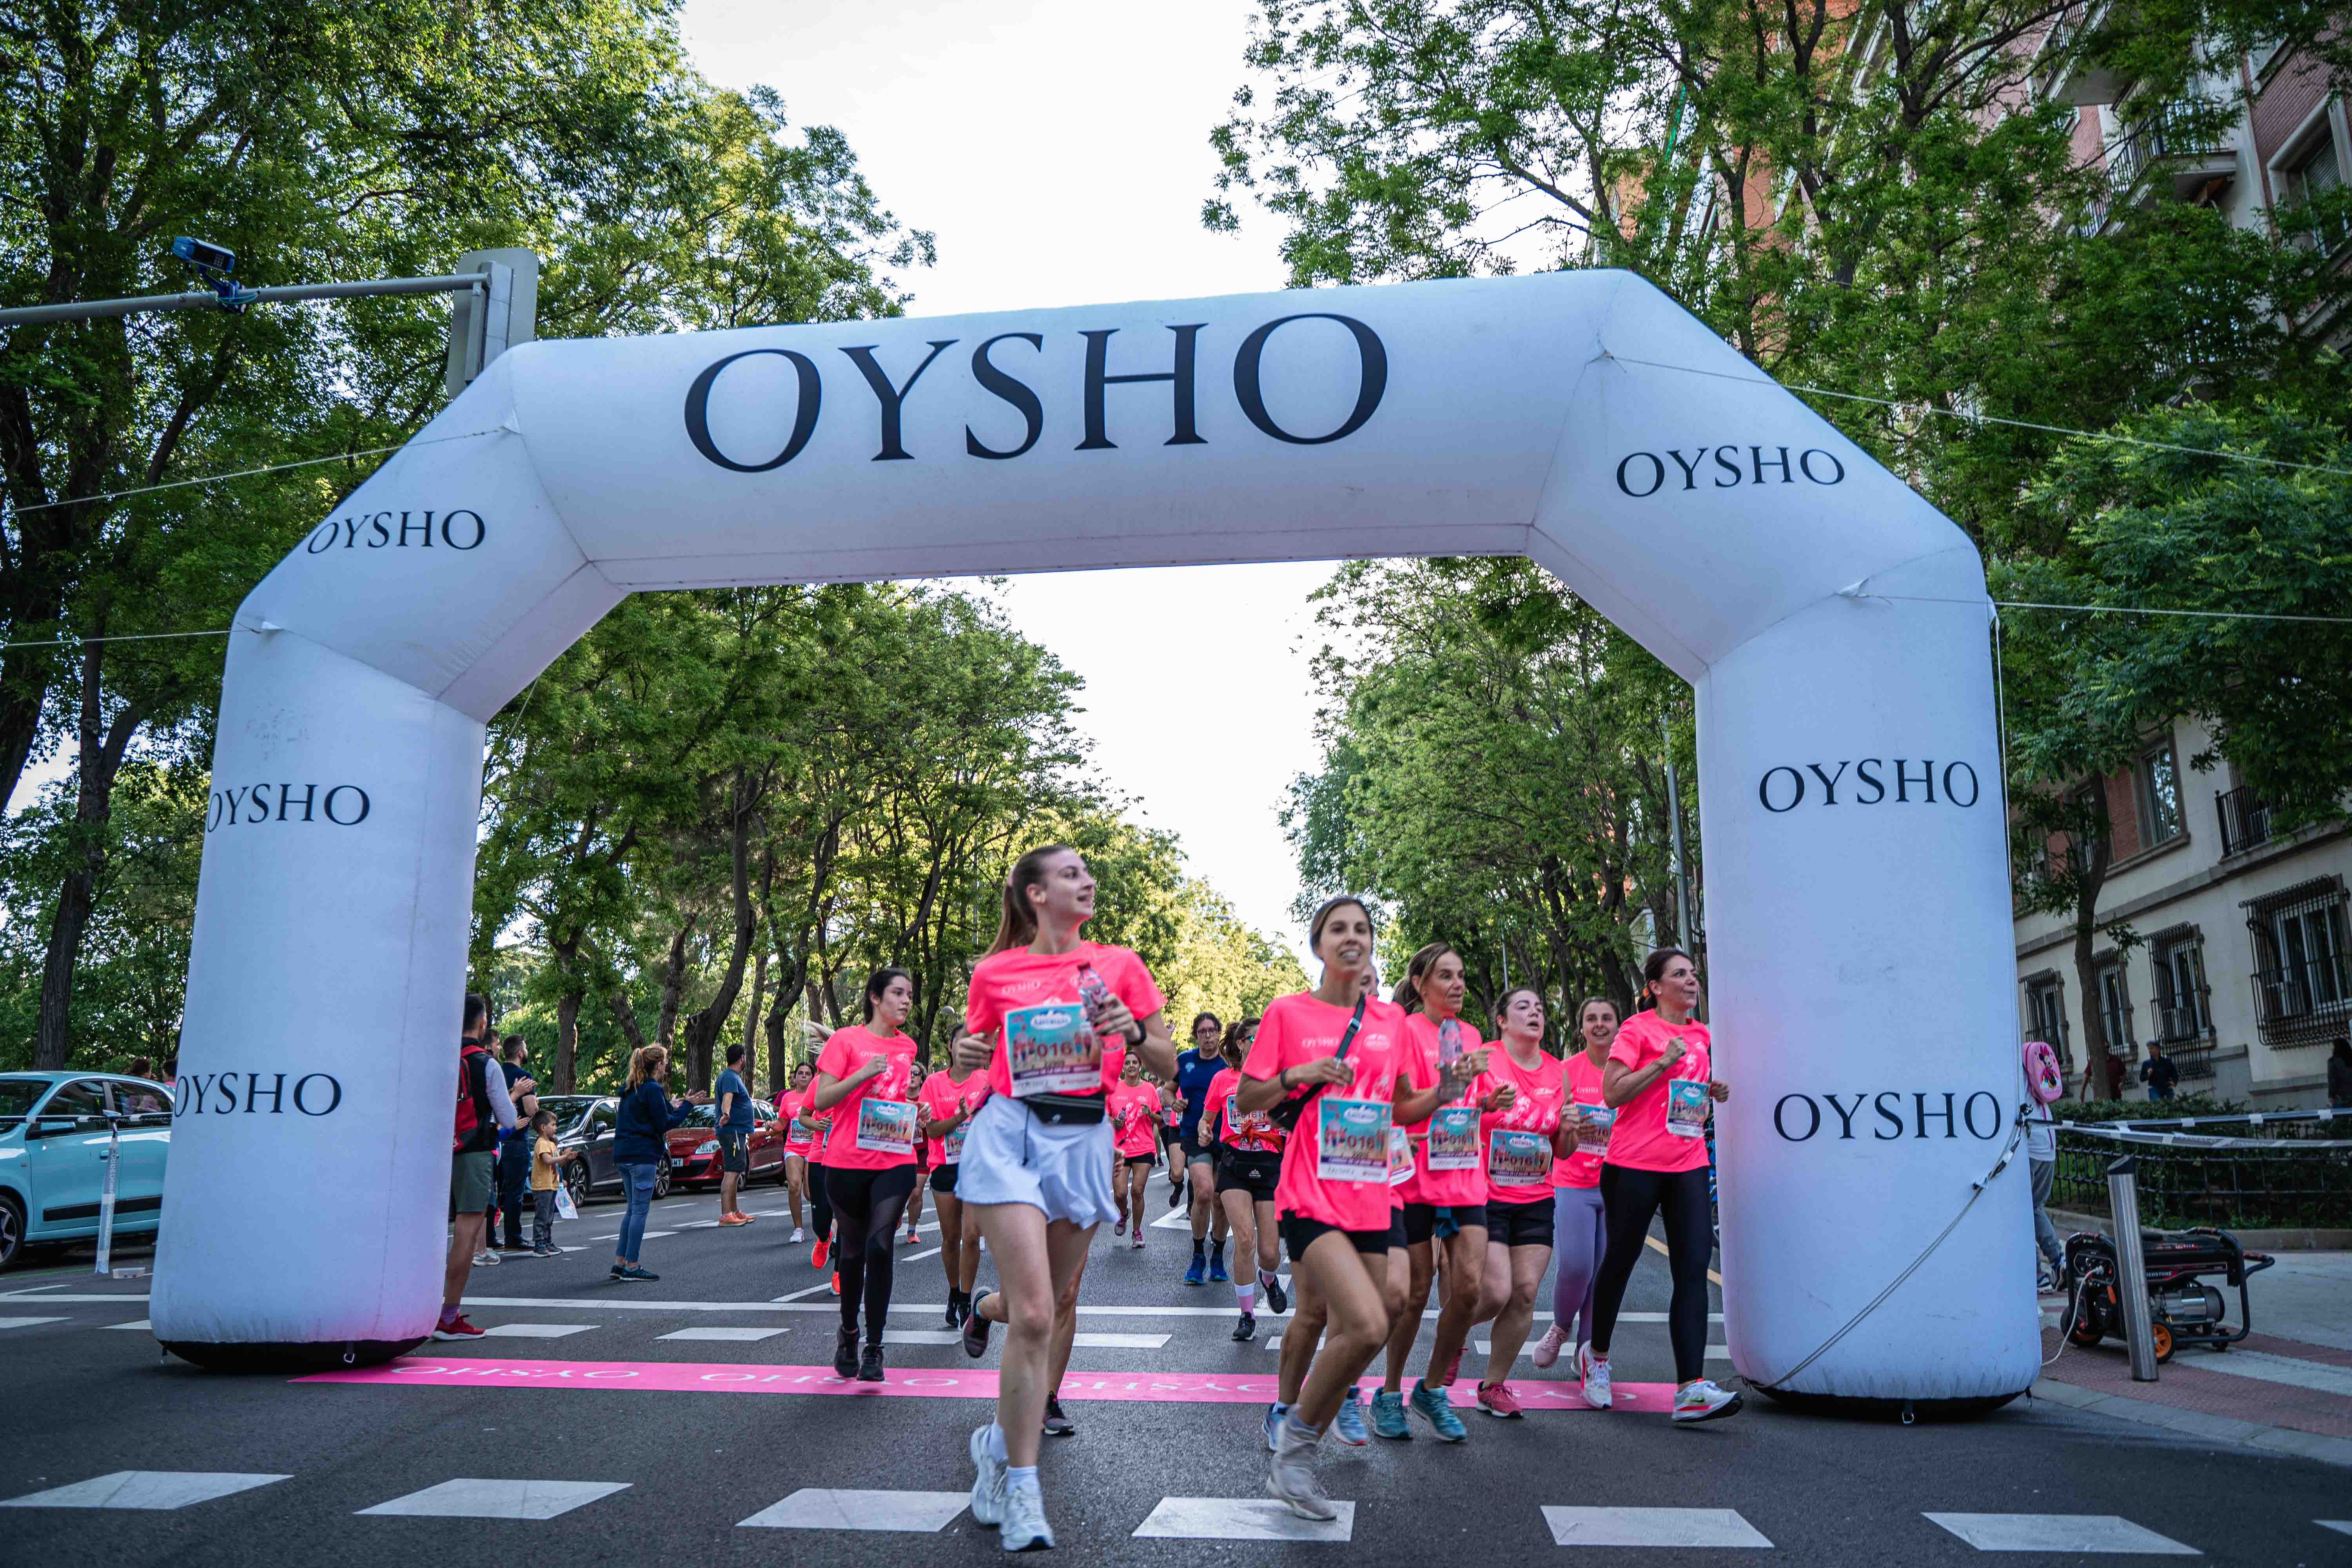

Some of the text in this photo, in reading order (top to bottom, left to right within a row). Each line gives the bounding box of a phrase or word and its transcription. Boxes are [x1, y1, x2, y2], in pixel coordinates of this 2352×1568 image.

[684, 313, 1388, 473] OYSHO
[1616, 445, 1845, 497] OYSHO
[307, 509, 486, 554] OYSHO
[207, 783, 371, 833] OYSHO
[1759, 759, 1979, 813] OYSHO
[1037, 1042, 1073, 1058] 016
[174, 1072, 342, 1118] OYSHO
[1773, 1091, 2001, 1142] OYSHO
[876, 1122, 897, 1132] 016
[391, 1365, 640, 1379] OYSHO
